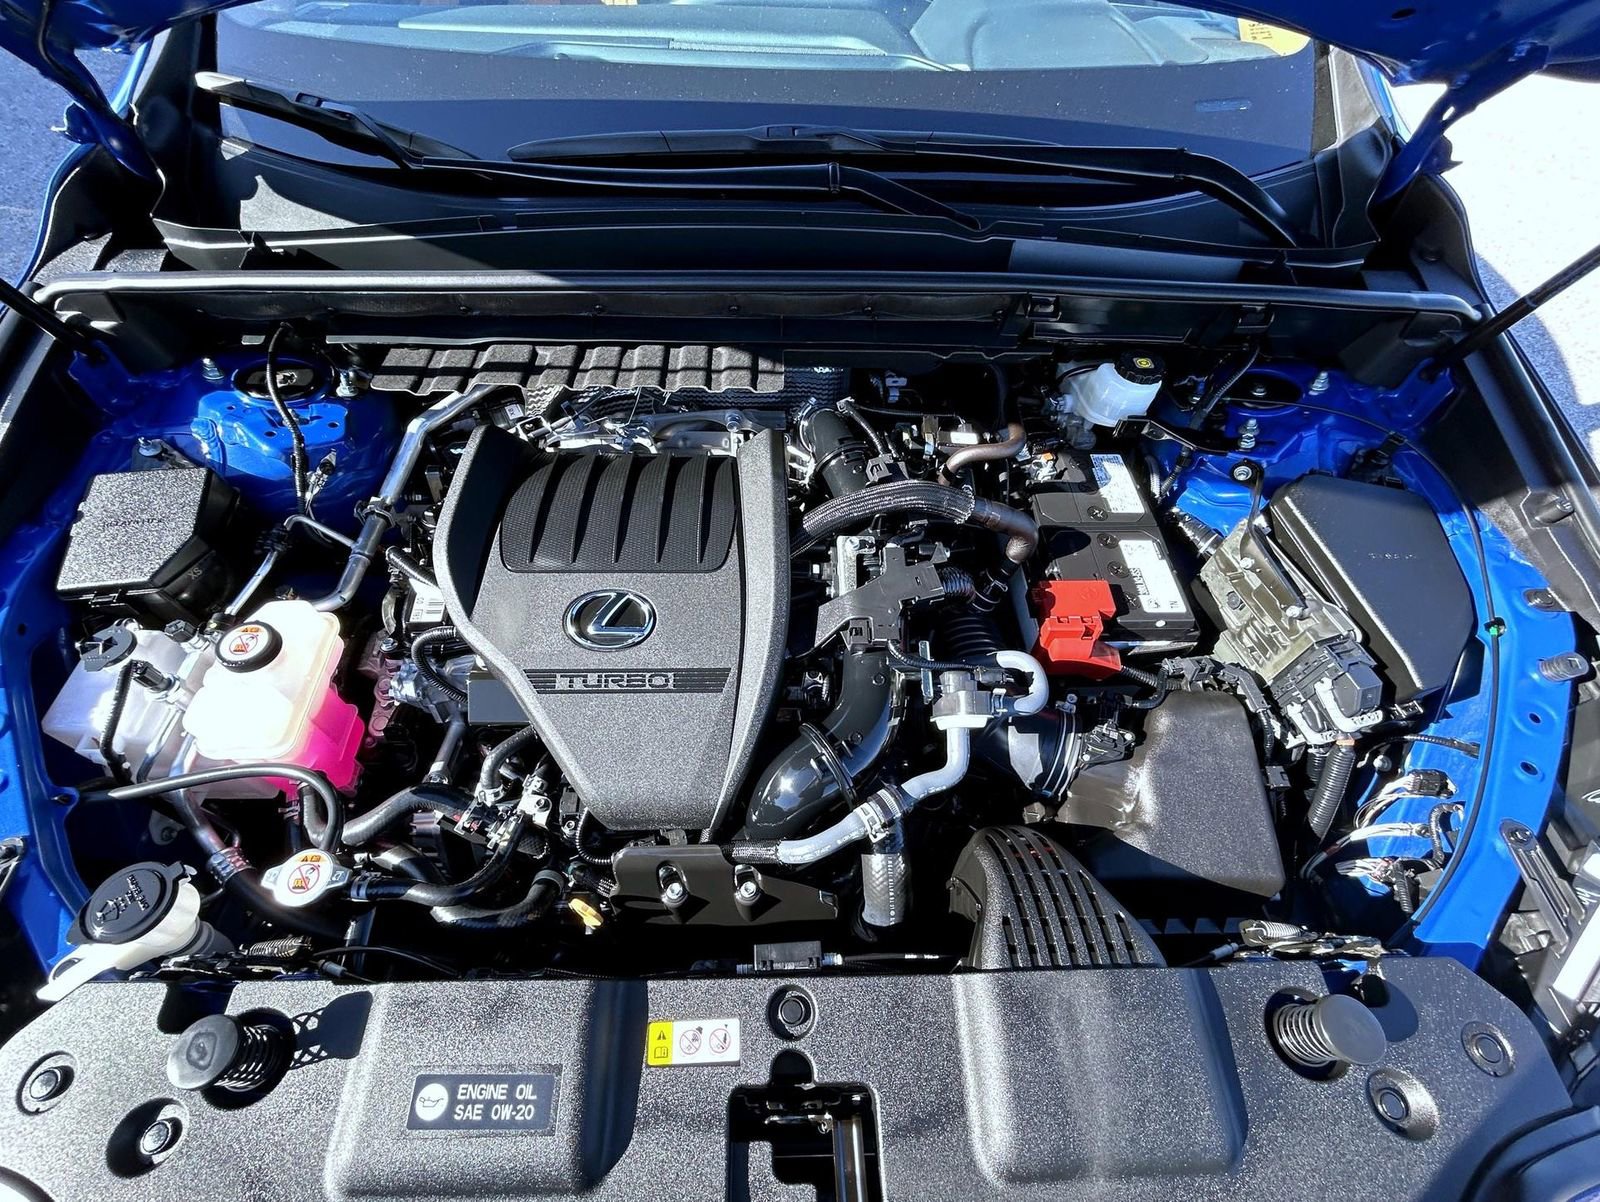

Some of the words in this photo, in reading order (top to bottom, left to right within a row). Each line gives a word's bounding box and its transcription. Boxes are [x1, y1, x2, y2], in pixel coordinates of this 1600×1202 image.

[559, 673, 670, 689] TURBO
[457, 1083, 508, 1100] ENGINE
[515, 1083, 537, 1100] OIL
[453, 1103, 483, 1121] SAE
[491, 1103, 535, 1121] 0W-20
